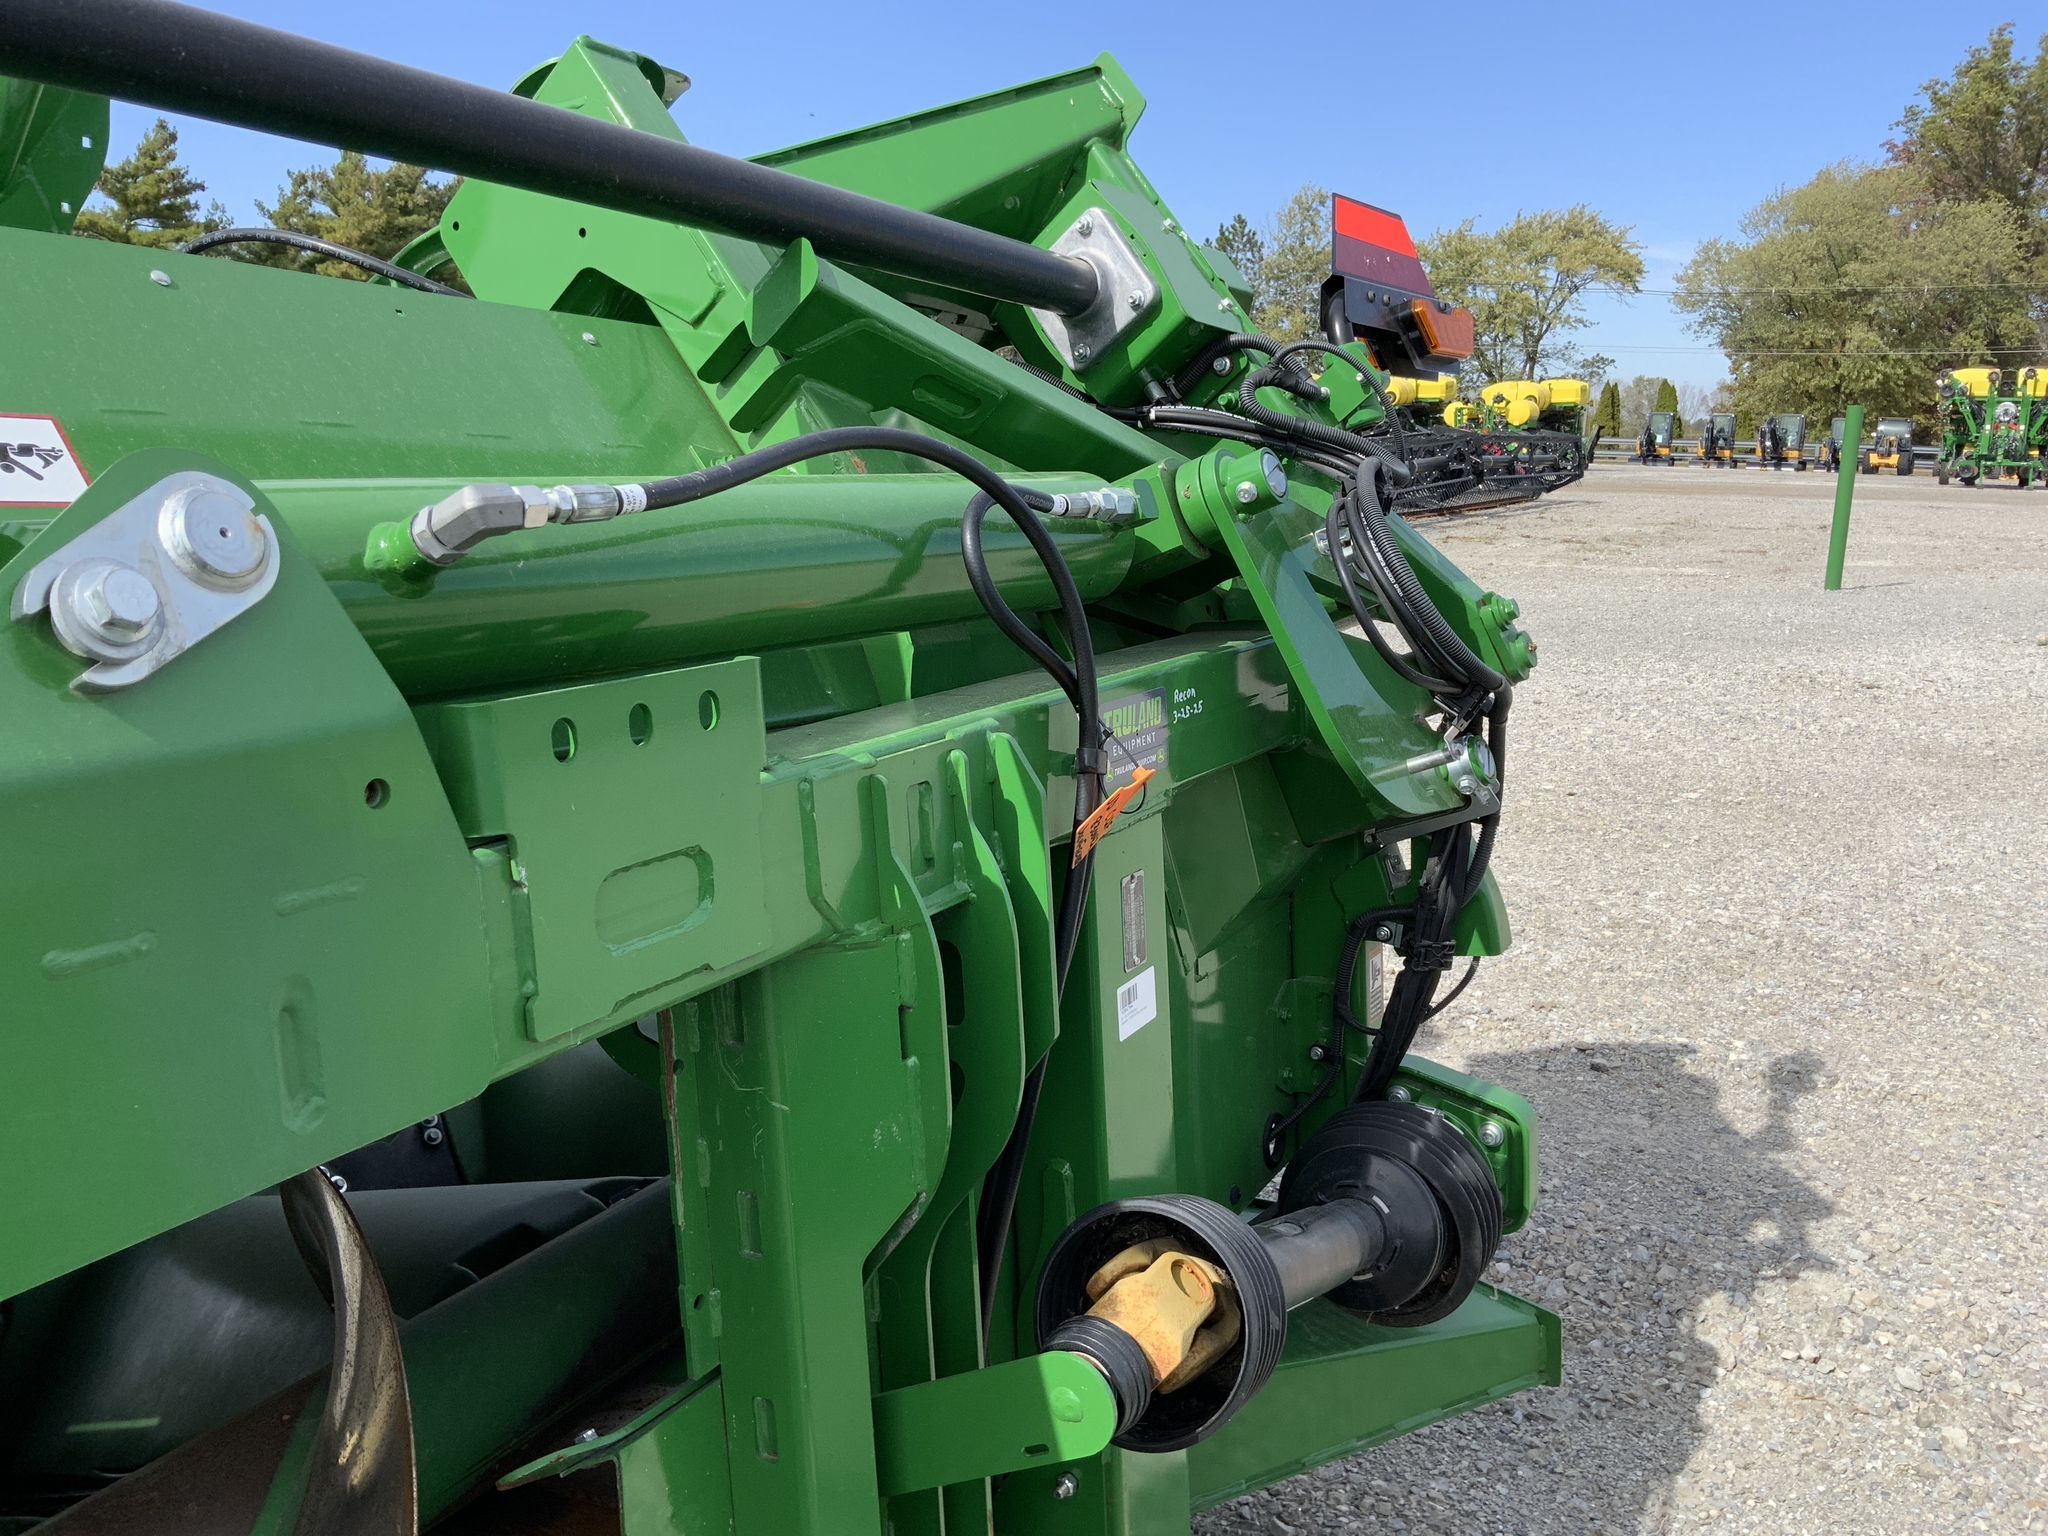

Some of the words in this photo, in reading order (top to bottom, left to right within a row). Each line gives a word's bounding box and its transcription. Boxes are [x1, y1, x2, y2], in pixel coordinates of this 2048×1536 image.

[1174, 687, 1196, 704] Recon
[1103, 696, 1162, 738] TRULAND
[1112, 731, 1156, 756] EQUIPMENT
